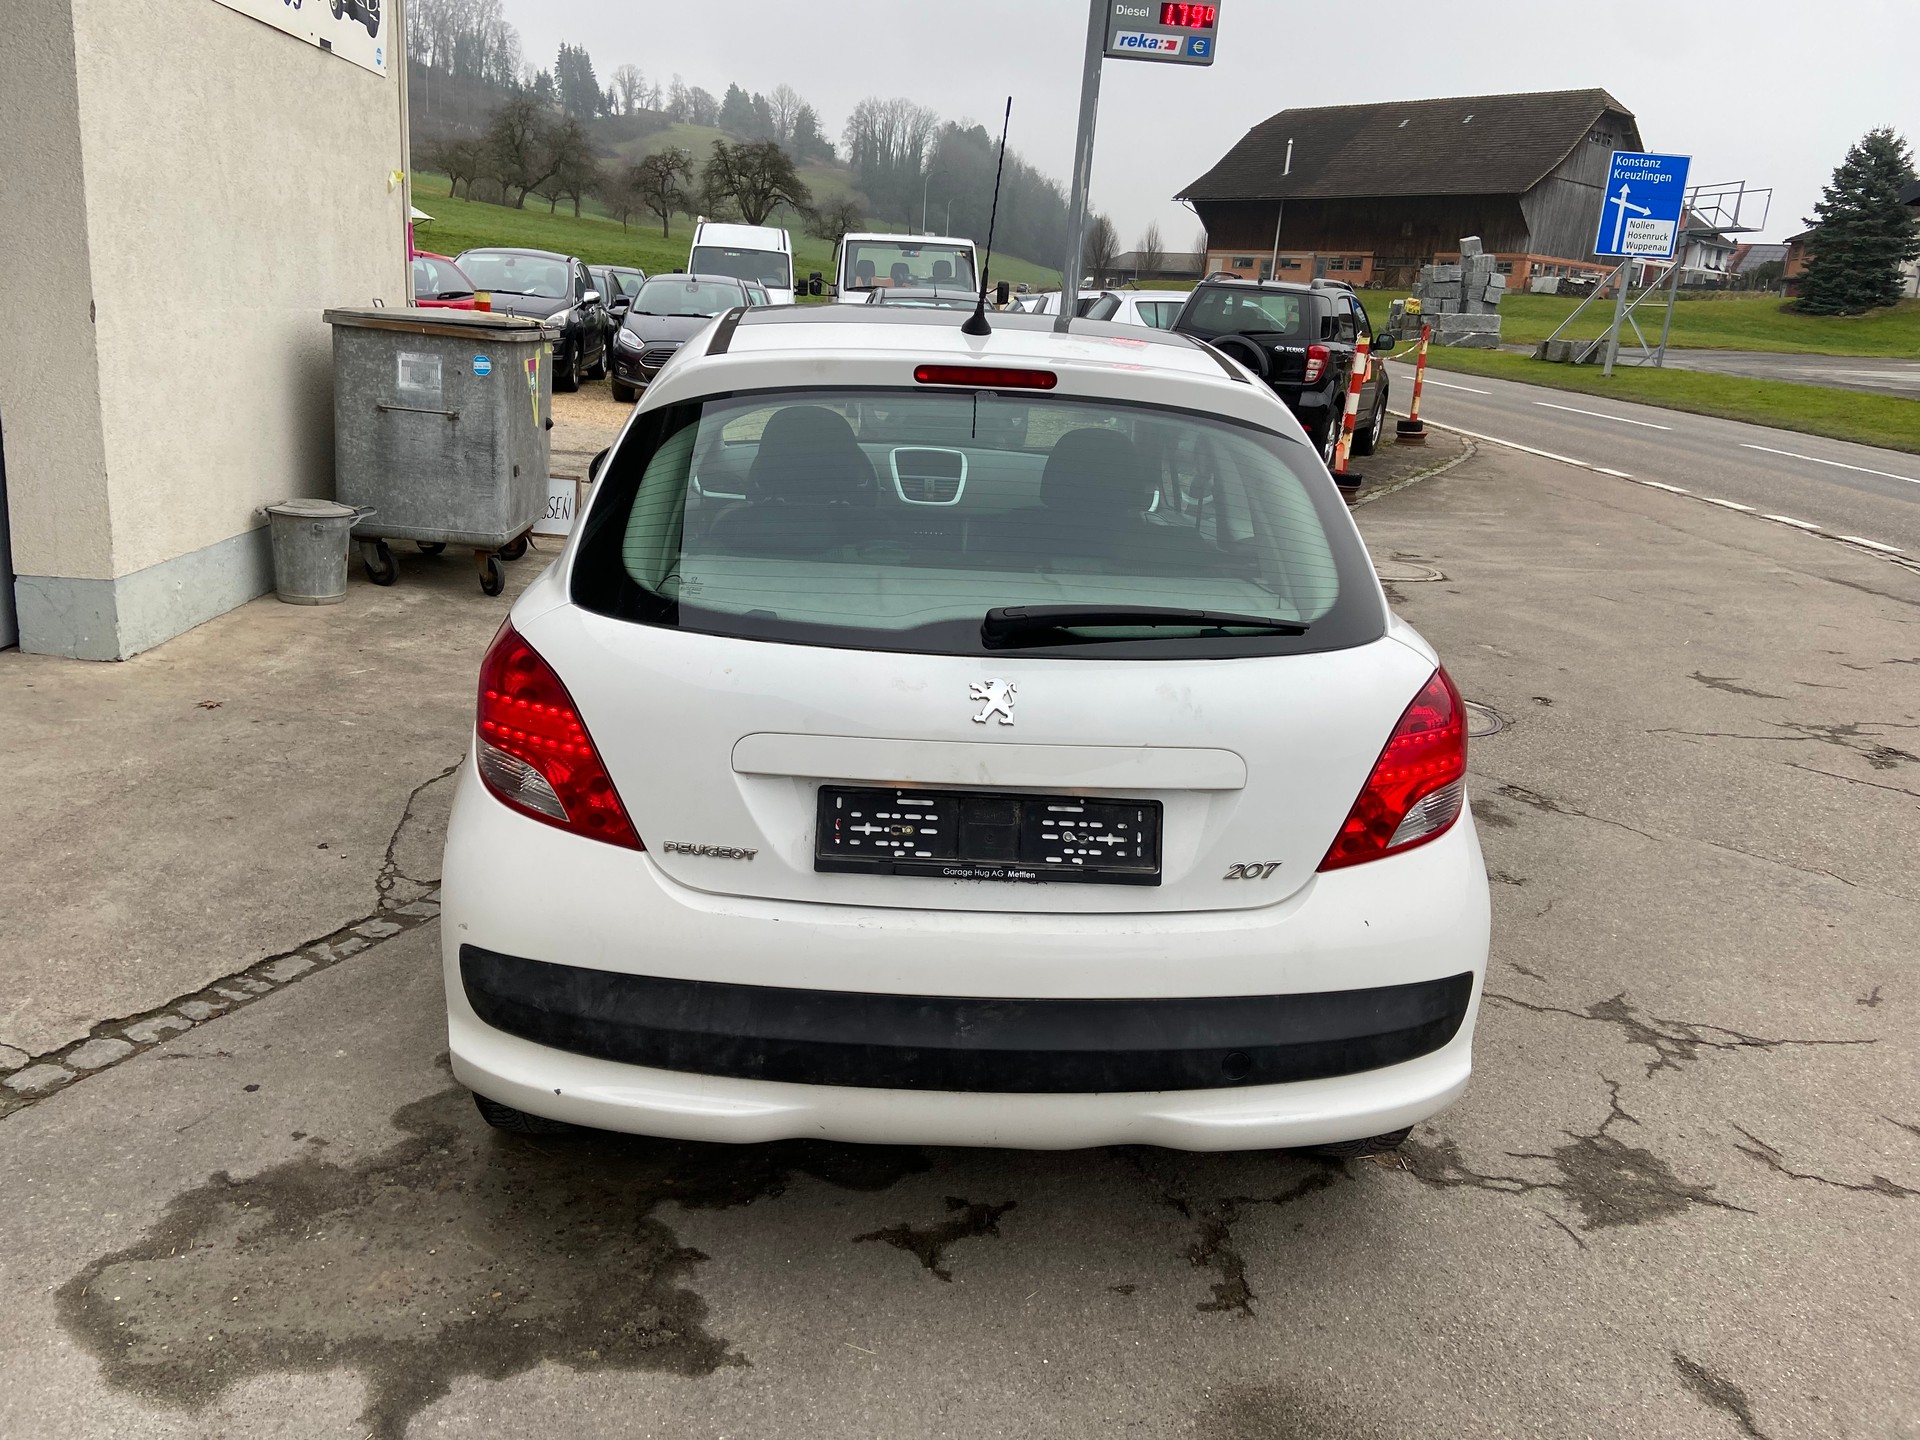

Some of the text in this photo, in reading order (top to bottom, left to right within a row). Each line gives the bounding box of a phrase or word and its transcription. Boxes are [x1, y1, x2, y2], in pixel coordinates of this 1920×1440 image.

[1116, 5, 1149, 17] Diesel
[1616, 156, 1661, 168] Konstanz
[1613, 169, 1672, 184] Kreuzlingen
[1629, 221, 1655, 230] Nollen
[1627, 232, 1668, 241] Hosenruck
[1626, 242, 1668, 252] Wuppenau
[663, 840, 758, 861] PEUGEOT
[943, 868, 973, 877] Garage
[974, 869, 990, 878] Hug
[1007, 871, 1036, 879] Mettlen
[1222, 860, 1282, 880] 207
